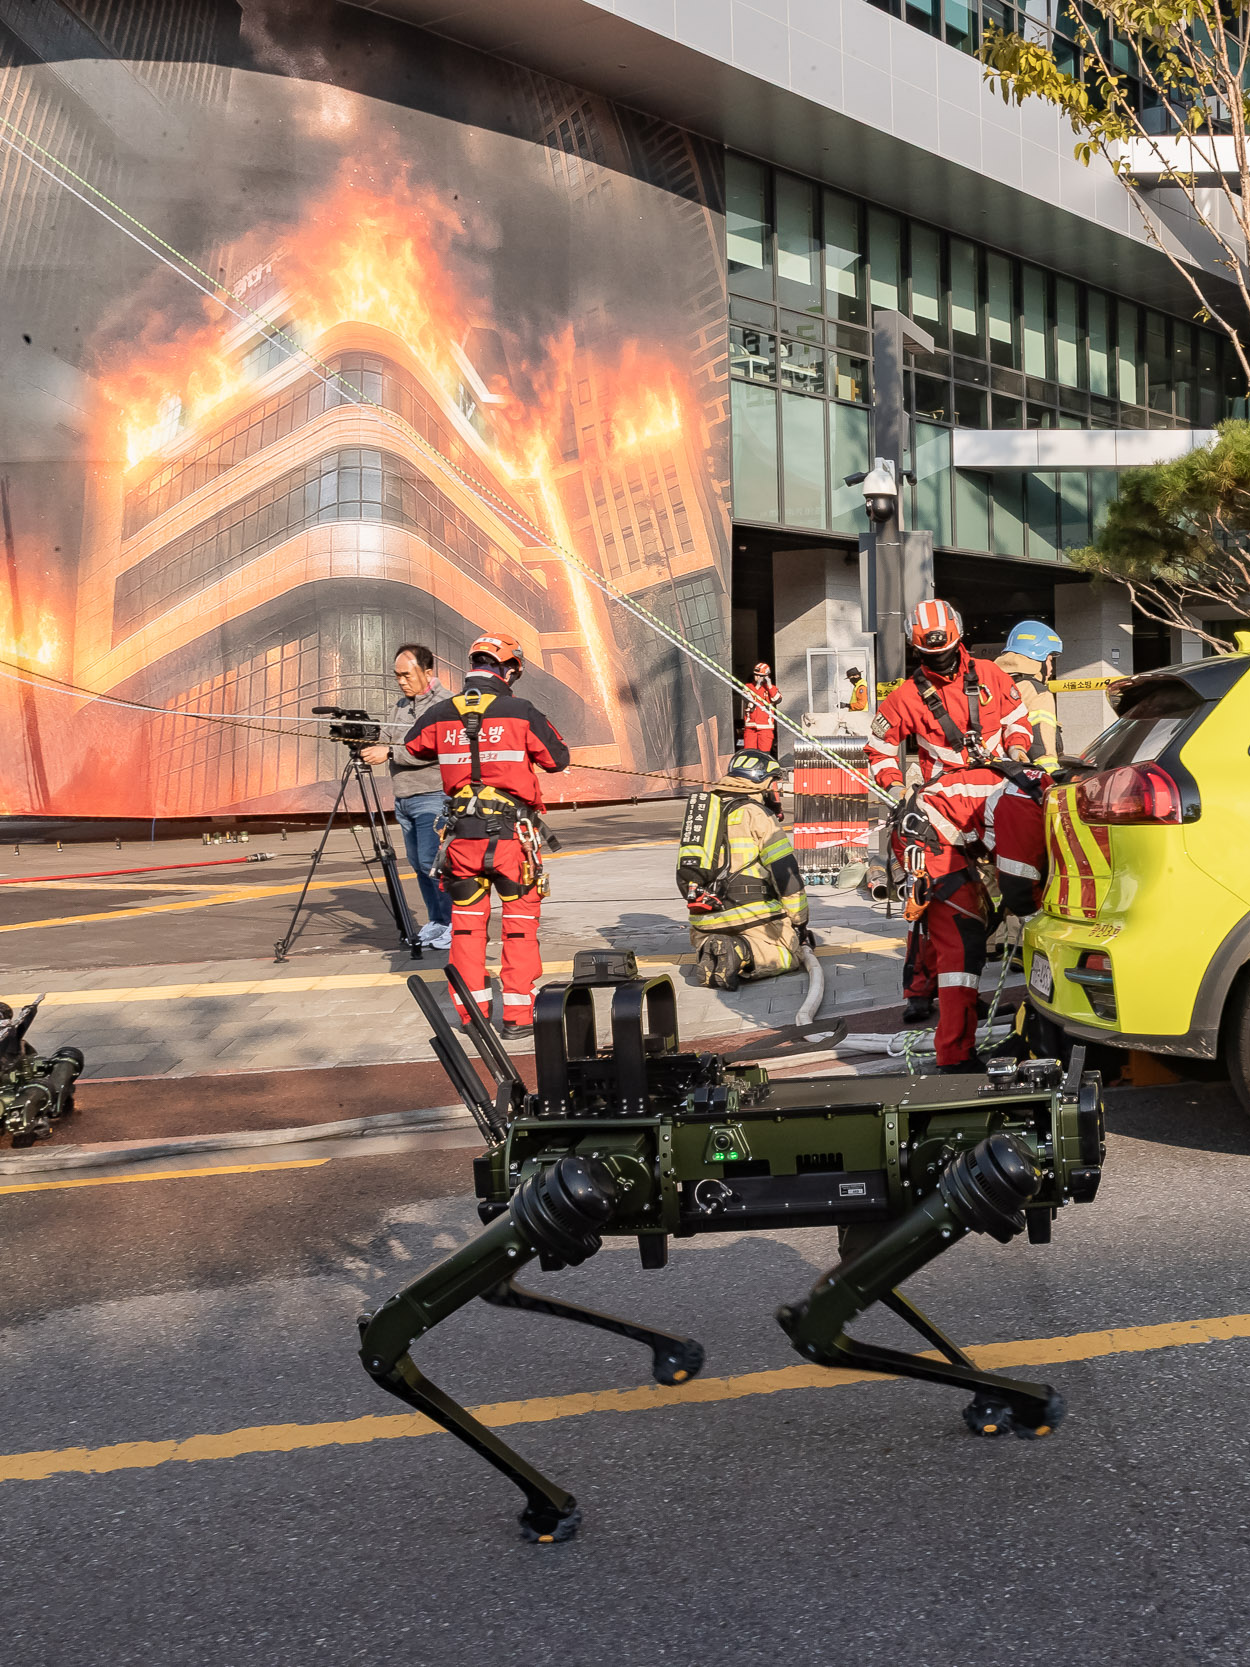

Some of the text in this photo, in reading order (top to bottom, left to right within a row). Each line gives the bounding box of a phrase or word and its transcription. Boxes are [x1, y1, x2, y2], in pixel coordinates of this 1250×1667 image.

[1063, 678, 1112, 690] 서울소방 119
[875, 711, 892, 731] FIRE
[443, 725, 505, 746] 서울소방
[691, 792, 709, 843] 광진소방서
